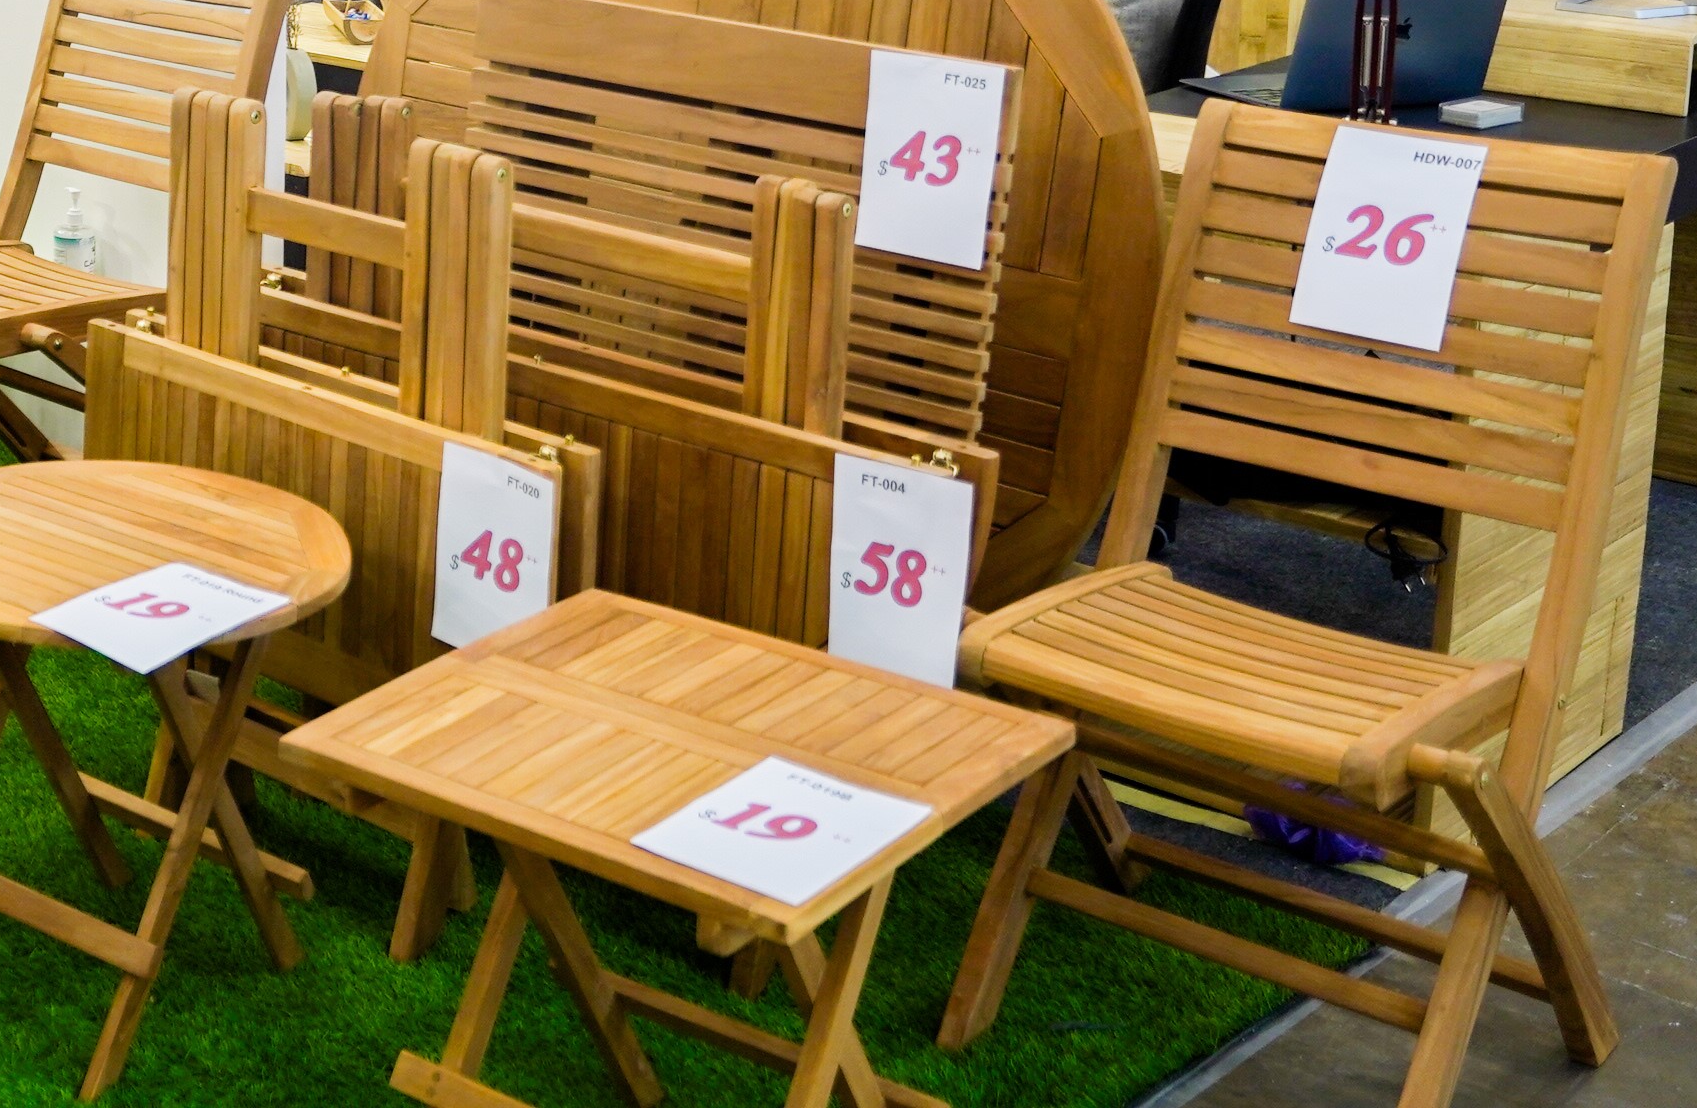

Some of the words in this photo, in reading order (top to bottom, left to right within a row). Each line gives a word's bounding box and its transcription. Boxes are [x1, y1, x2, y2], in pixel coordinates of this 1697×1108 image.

[944, 73, 986, 90] FT-025
[1413, 151, 1481, 170] HDW-007
[507, 476, 540, 499] FT-020
[861, 474, 906, 494] FT-004
